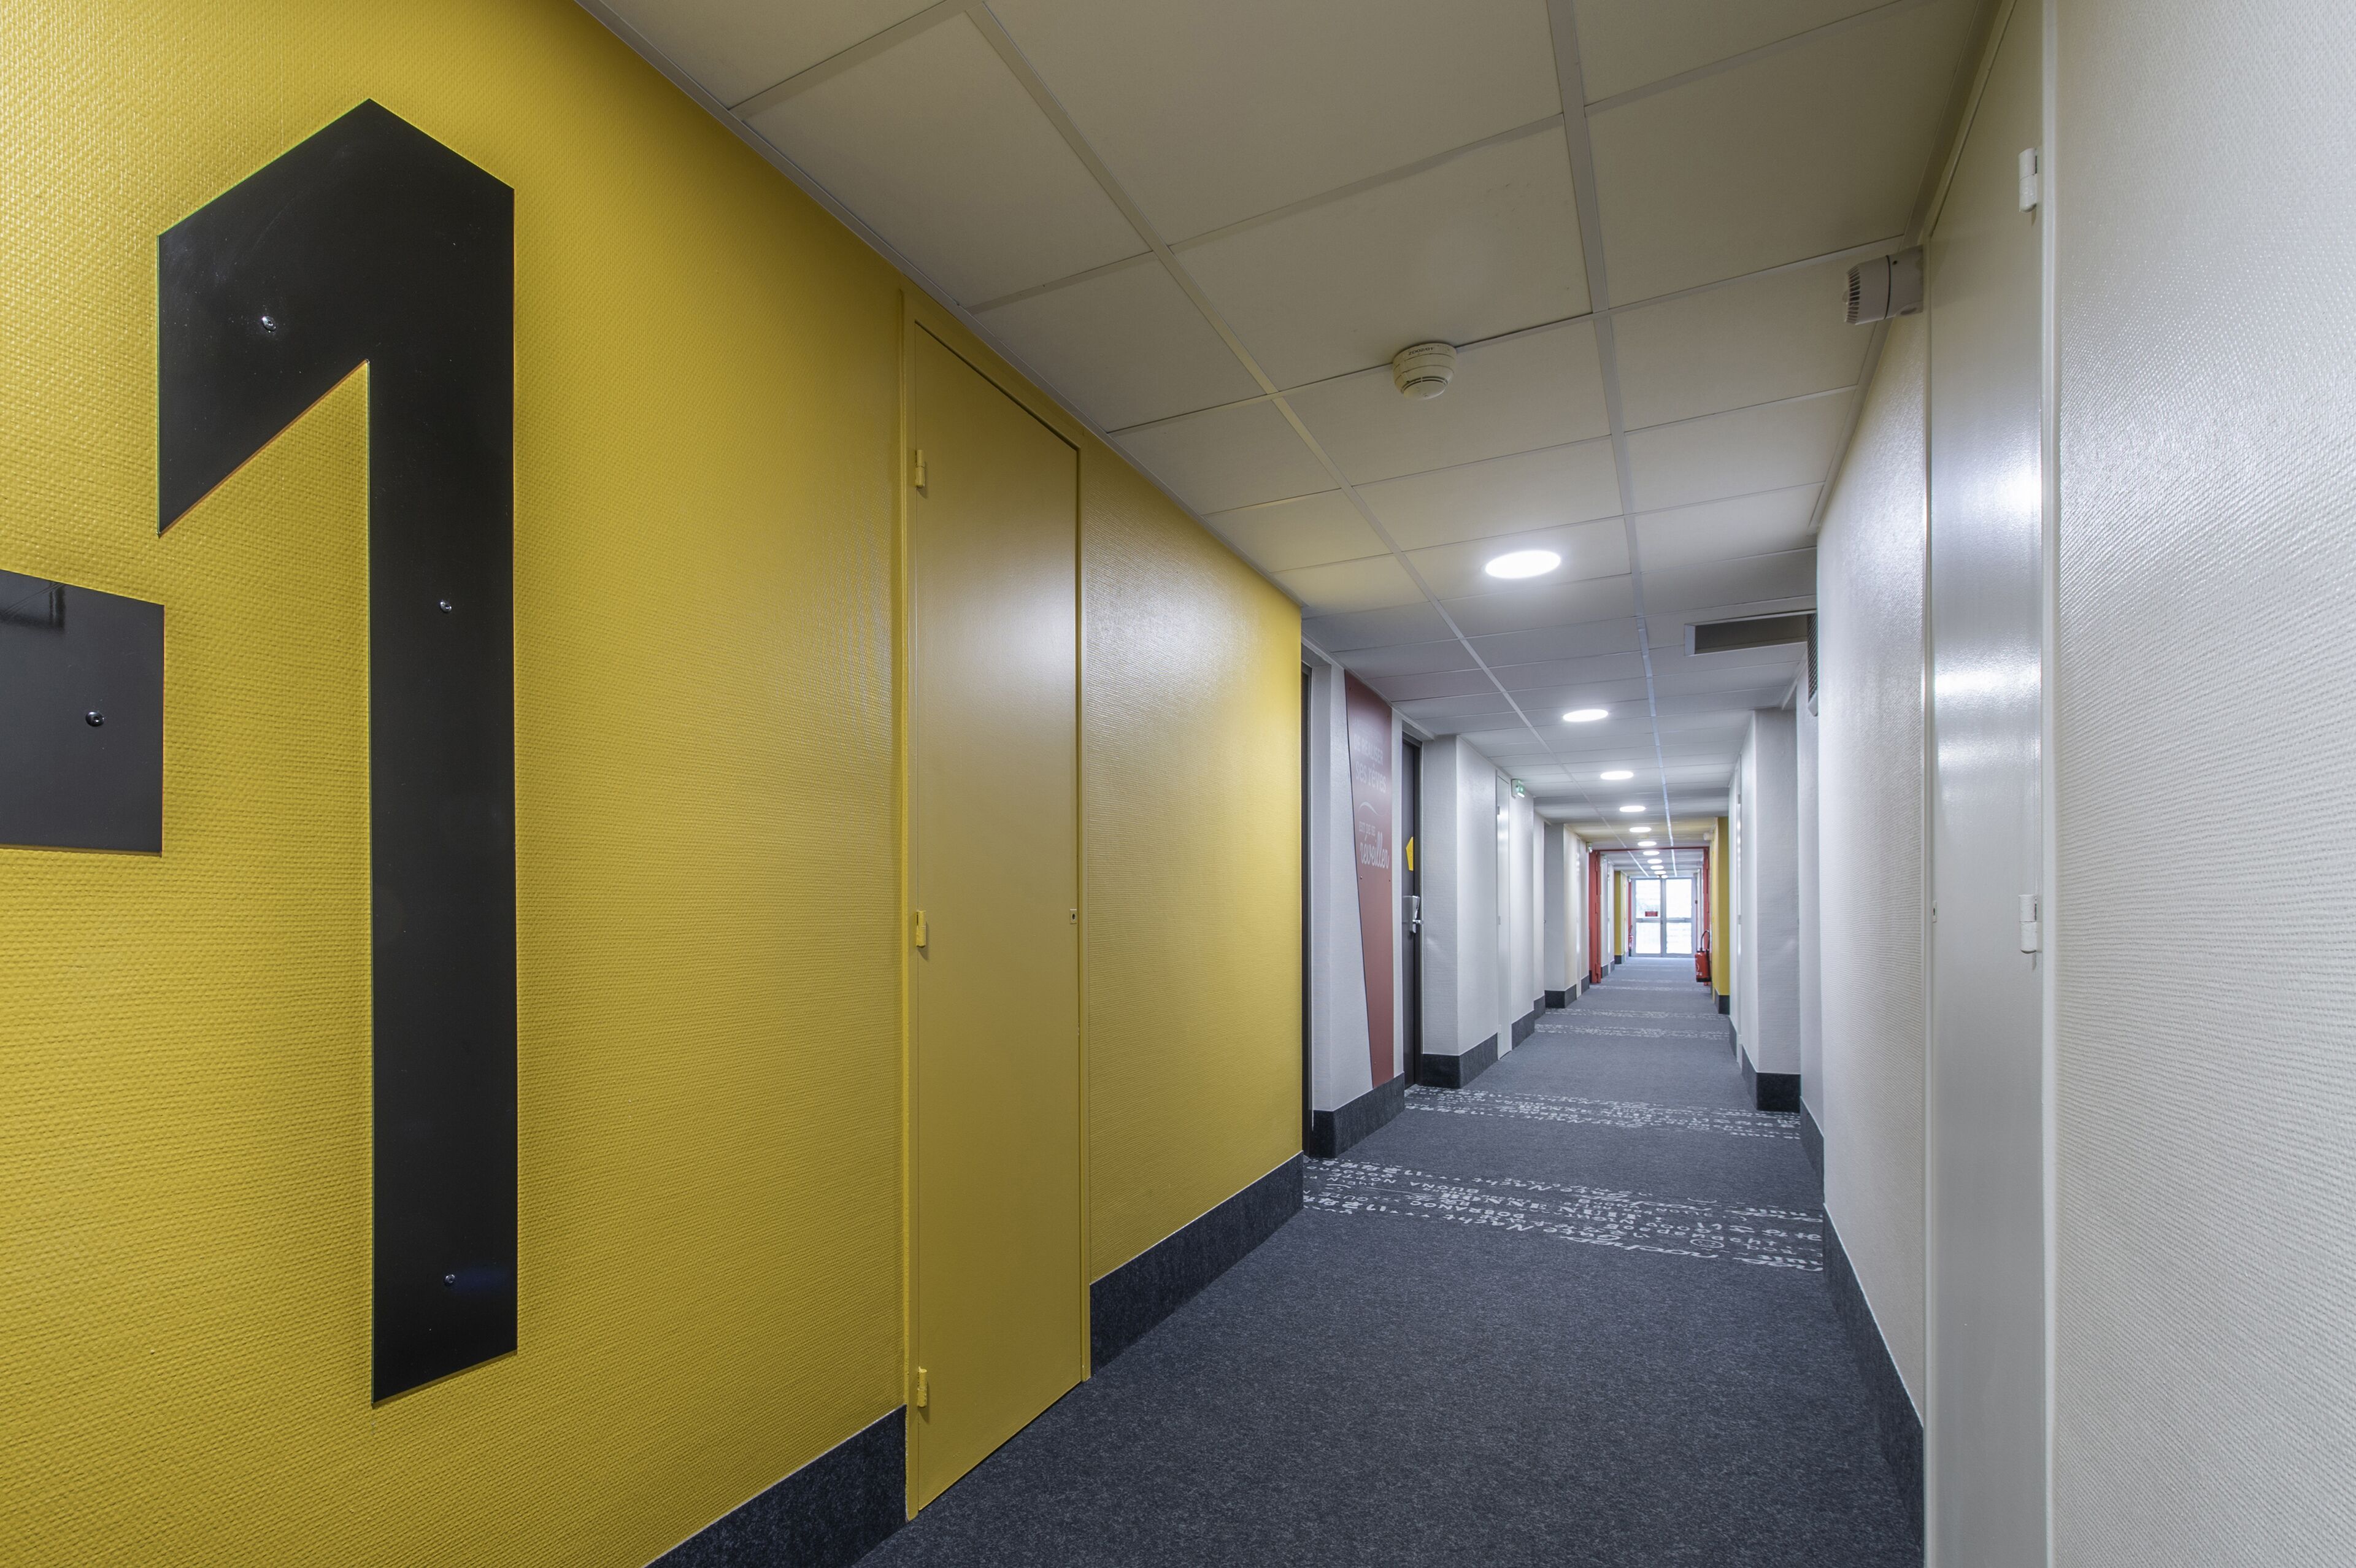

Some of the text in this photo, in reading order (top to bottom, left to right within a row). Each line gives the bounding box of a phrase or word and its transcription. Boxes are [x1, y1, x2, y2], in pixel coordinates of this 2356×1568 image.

[1355, 761, 1387, 793] ses rêves
[1360, 831, 1390, 869] réveiller
